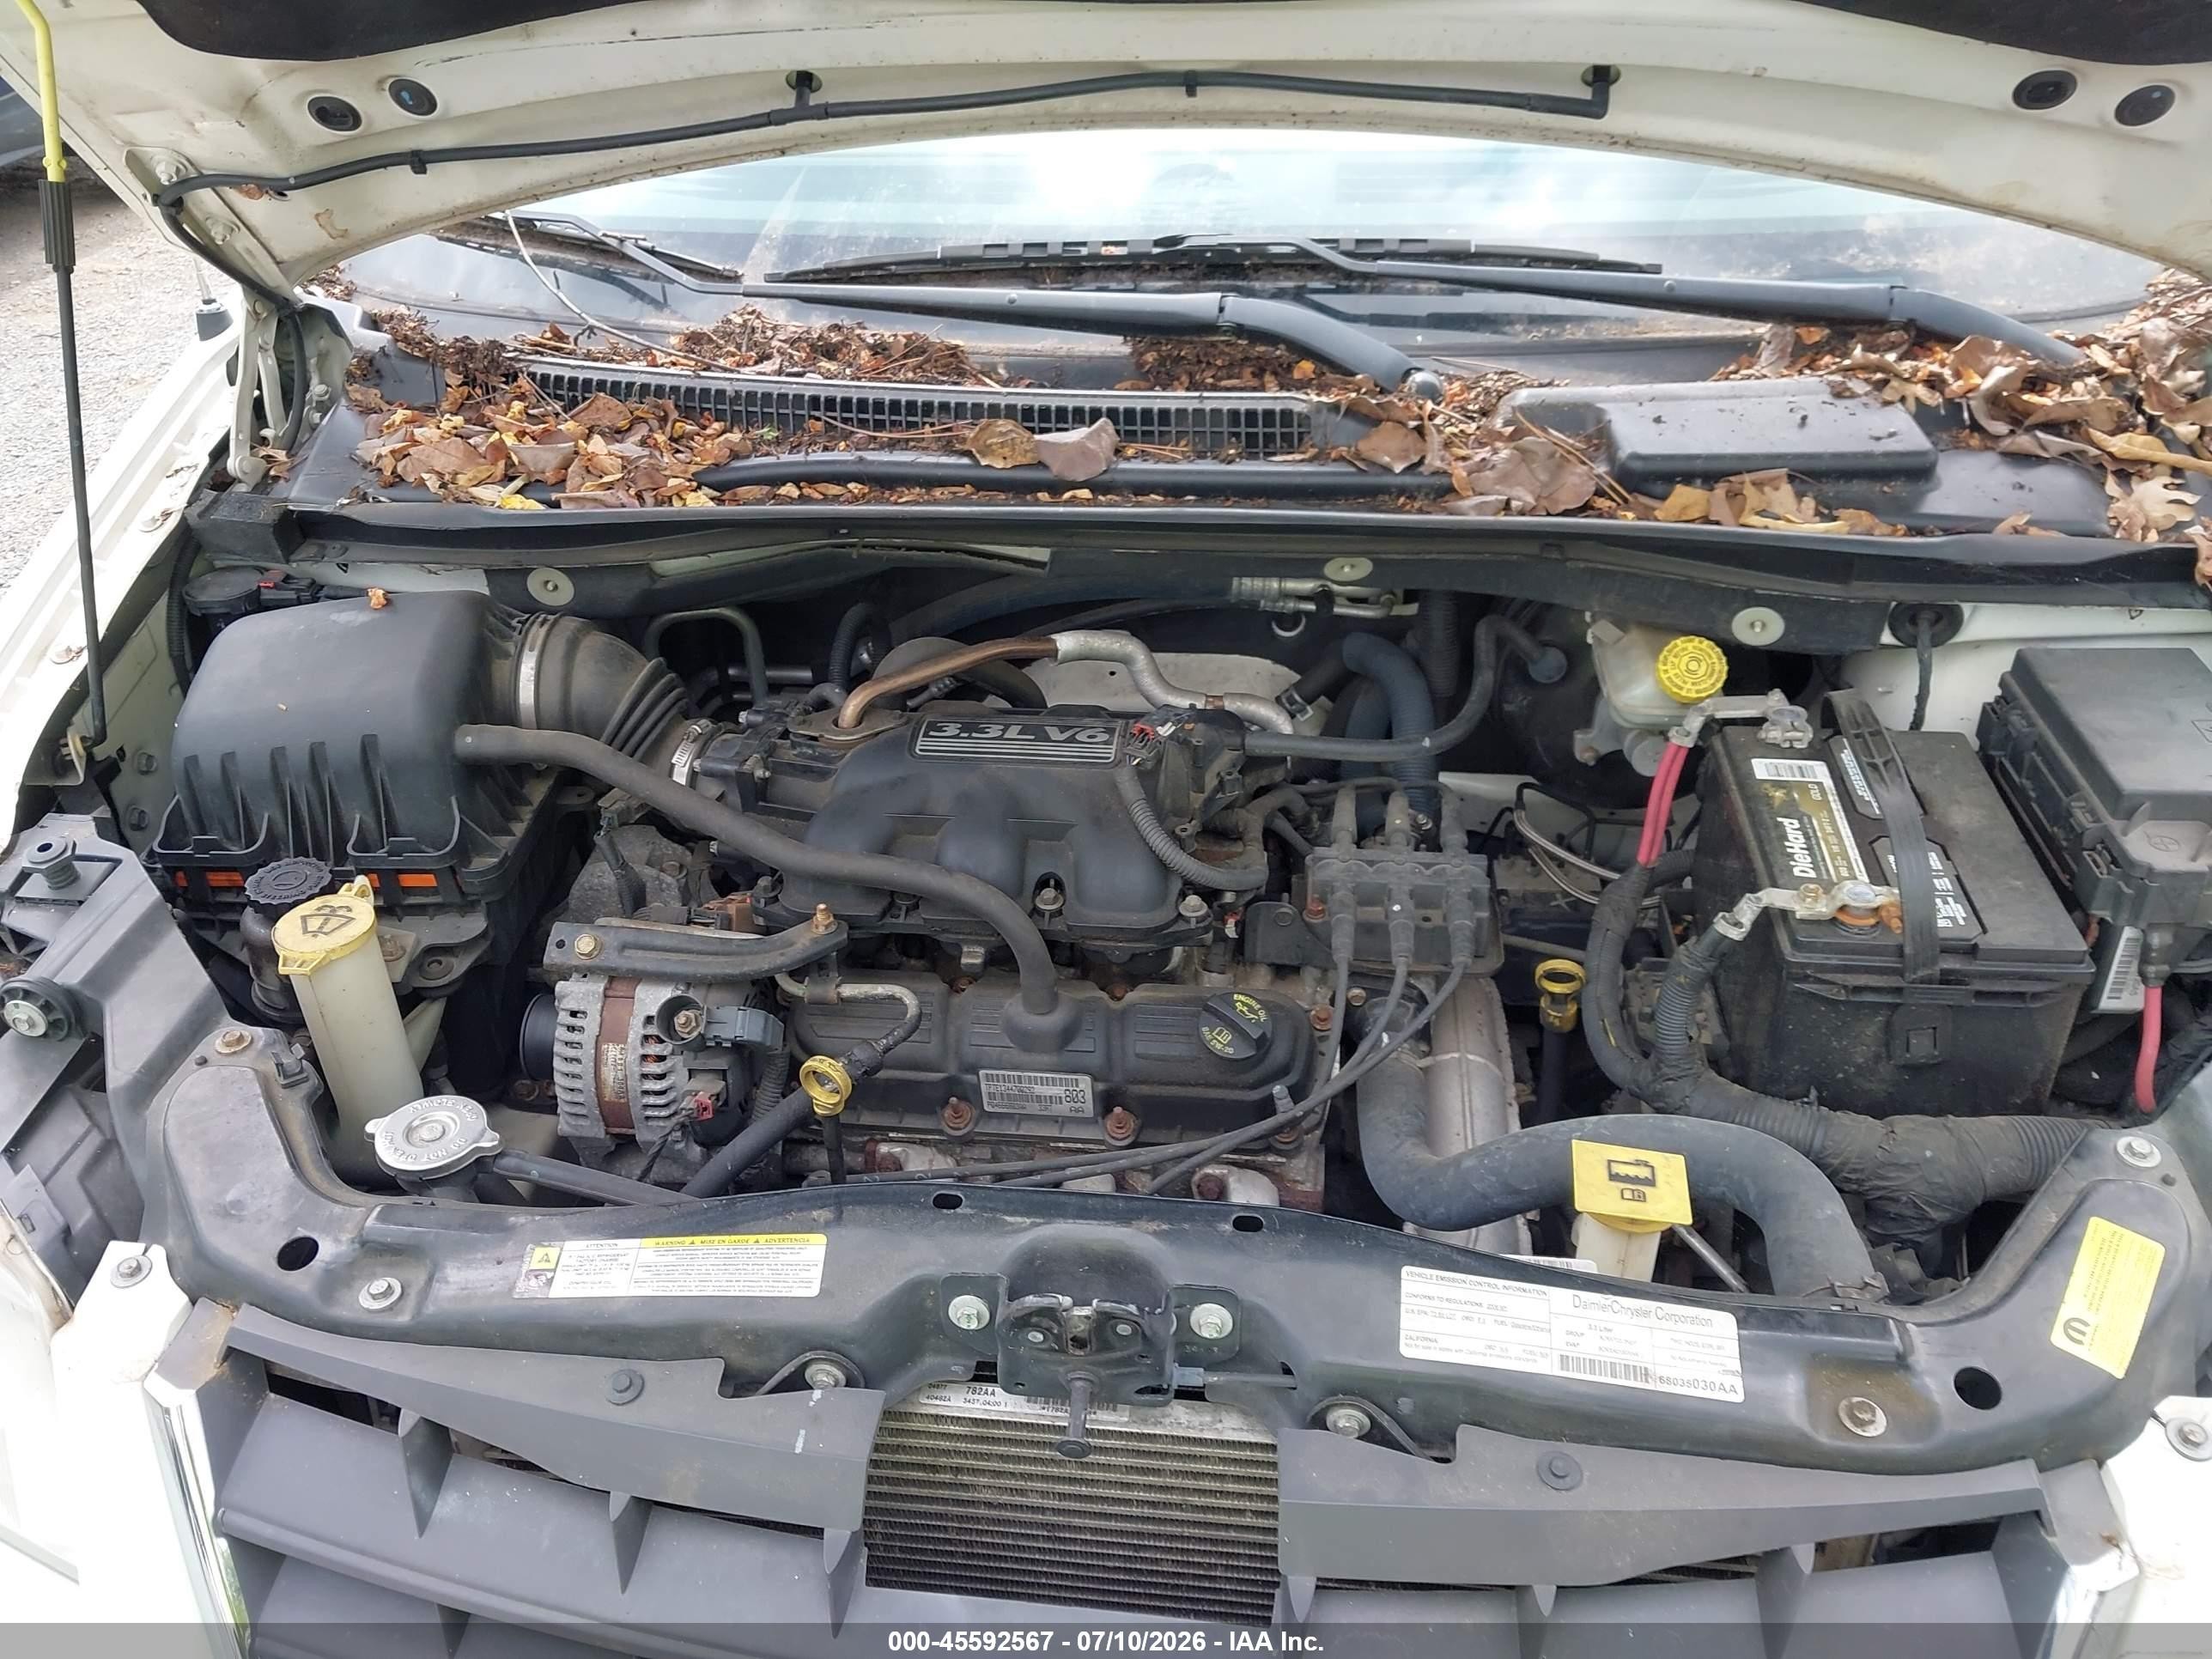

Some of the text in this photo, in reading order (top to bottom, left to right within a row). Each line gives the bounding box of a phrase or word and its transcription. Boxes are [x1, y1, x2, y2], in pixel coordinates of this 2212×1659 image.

[928, 723, 1110, 743] 3.3L V6
[1808, 783, 1822, 800] GOLD
[1777, 817, 1817, 878] DieHard
[1233, 994, 1268, 1023] ENGINE OIL
[1210, 1039, 1235, 1054] 5W-20
[451, 1138, 468, 1150] DO
[392, 1146, 417, 1161] OPEN
[421, 1148, 447, 1162] NOT
[1405, 1270, 1548, 1297] VEHICLE EMISSION CONTROL INFORMATION
[1572, 1294, 1713, 1328] DaimlerChrysler Corporation
[965, 1386, 996, 1398] 782AA
